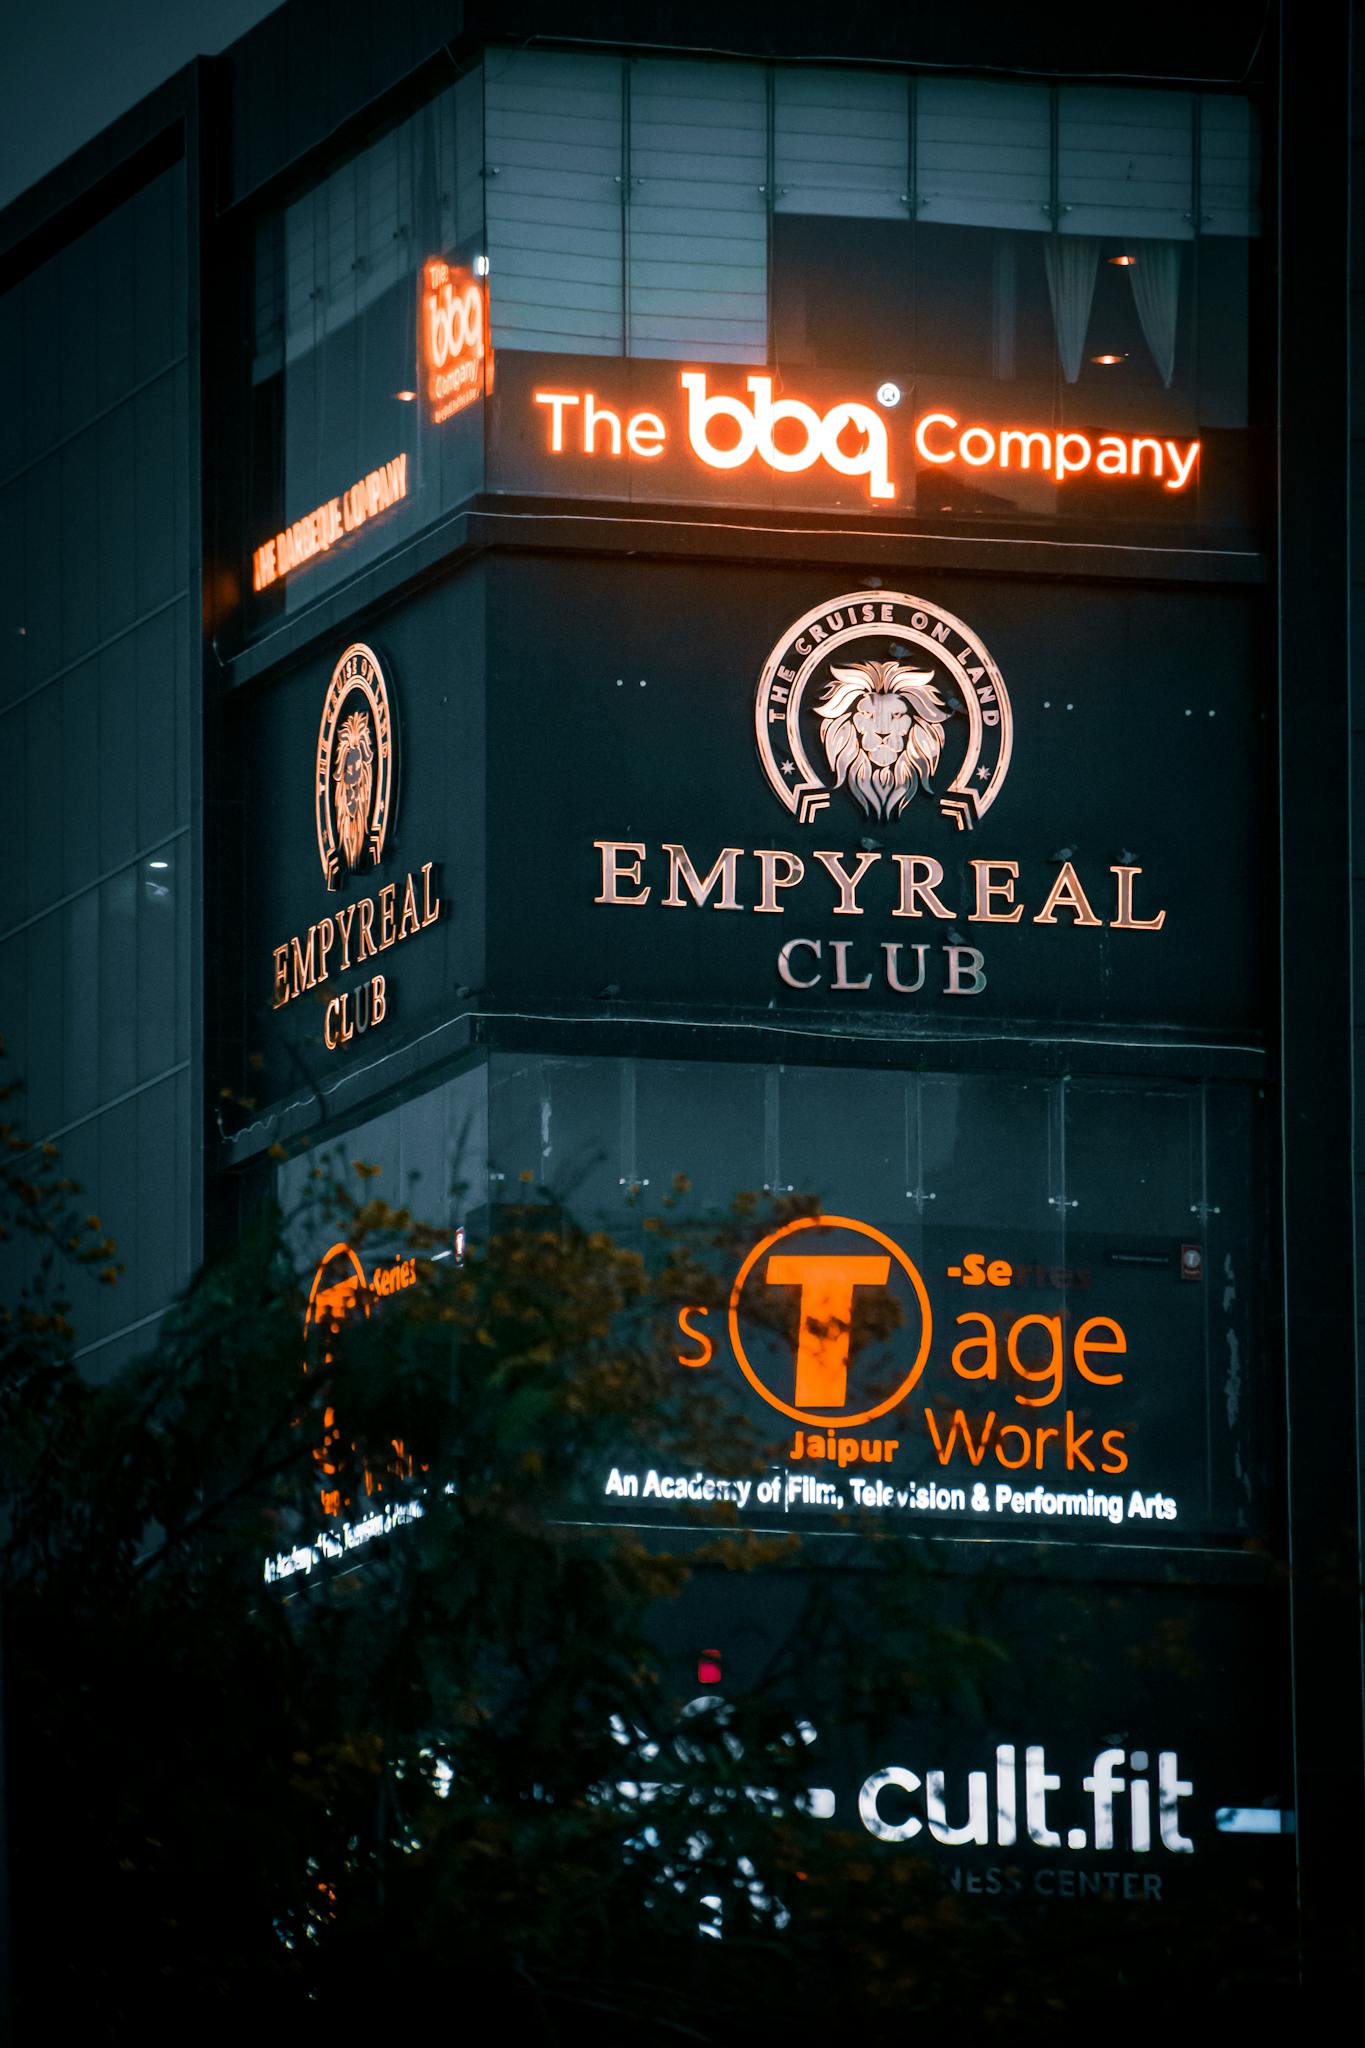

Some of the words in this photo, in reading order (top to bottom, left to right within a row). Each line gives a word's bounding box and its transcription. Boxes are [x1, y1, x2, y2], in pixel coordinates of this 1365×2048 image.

[429, 263, 449, 290] The
[429, 283, 485, 369] bbq
[435, 358, 480, 399] Company
[534, 392, 665, 458] The
[915, 413, 1201, 491] Company
[276, 497, 344, 577] BARBEQUE
[343, 452, 407, 532] COMPANY
[769, 665, 797, 724] THE
[794, 603, 896, 657] CRUISE
[910, 611, 952, 645] ON
[956, 646, 1000, 728] LAND
[592, 840, 1167, 932] EMPYREAL
[272, 860, 441, 1010] EMPYREAL
[776, 937, 988, 995] CLUB
[324, 973, 387, 1051] CLUB
[789, 1429, 900, 1469] Jaipur
[924, 1407, 1130, 1474] Works
[605, 1468, 638, 1498] An
[642, 1469, 752, 1508] Academy
[757, 1475, 783, 1502] of
[788, 1476, 844, 1510] Film,
[850, 1478, 966, 1510] Television
[971, 1482, 991, 1511] &
[996, 1484, 1124, 1524] Performing
[1127, 1491, 1179, 1522] Arts
[858, 1743, 1195, 1854] cult.fit
[947, 1865, 1023, 1895] NESS
[1034, 1868, 1164, 1902] CENTER
